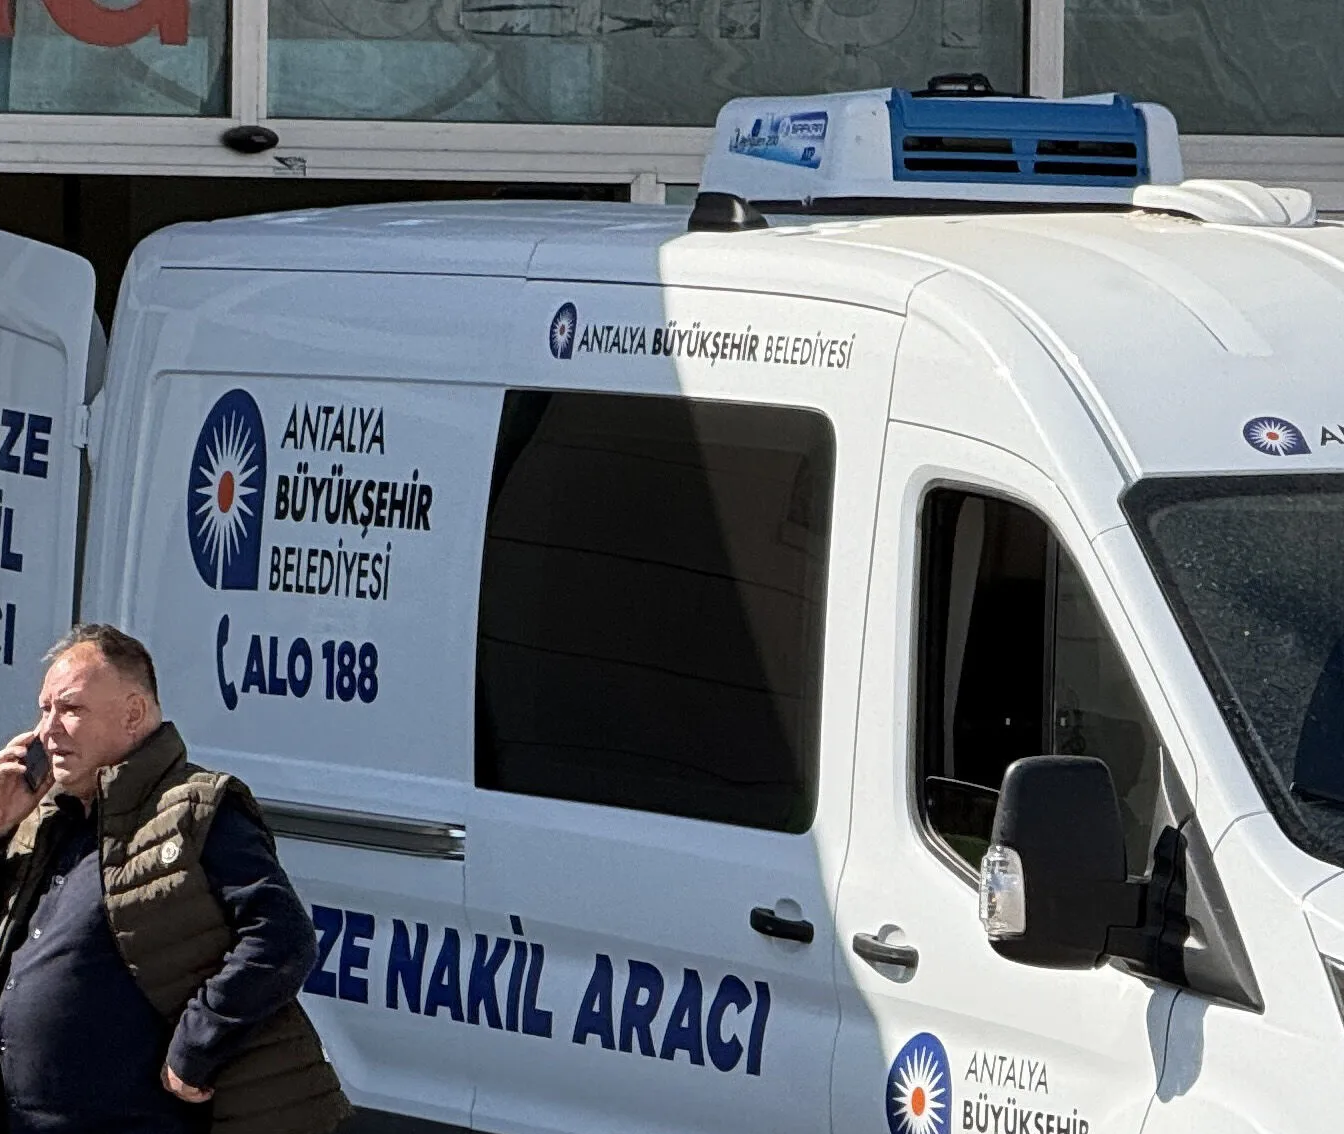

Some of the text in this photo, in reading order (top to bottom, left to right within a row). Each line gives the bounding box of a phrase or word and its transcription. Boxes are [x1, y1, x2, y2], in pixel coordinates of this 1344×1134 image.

[578, 320, 856, 369] ANTALYA BÜYÜKŞEHİR BELEDİYESİ
[281, 403, 385, 455] ANTALYA
[274, 461, 433, 539] BÜYÜKŞEHİR
[268, 537, 392, 600] BELEDİYESİ
[240, 634, 378, 704] ALO 188
[386, 914, 553, 1038] NAKİL
[572, 953, 772, 1076] ARACI
[965, 1051, 1049, 1094] ANTALYA
